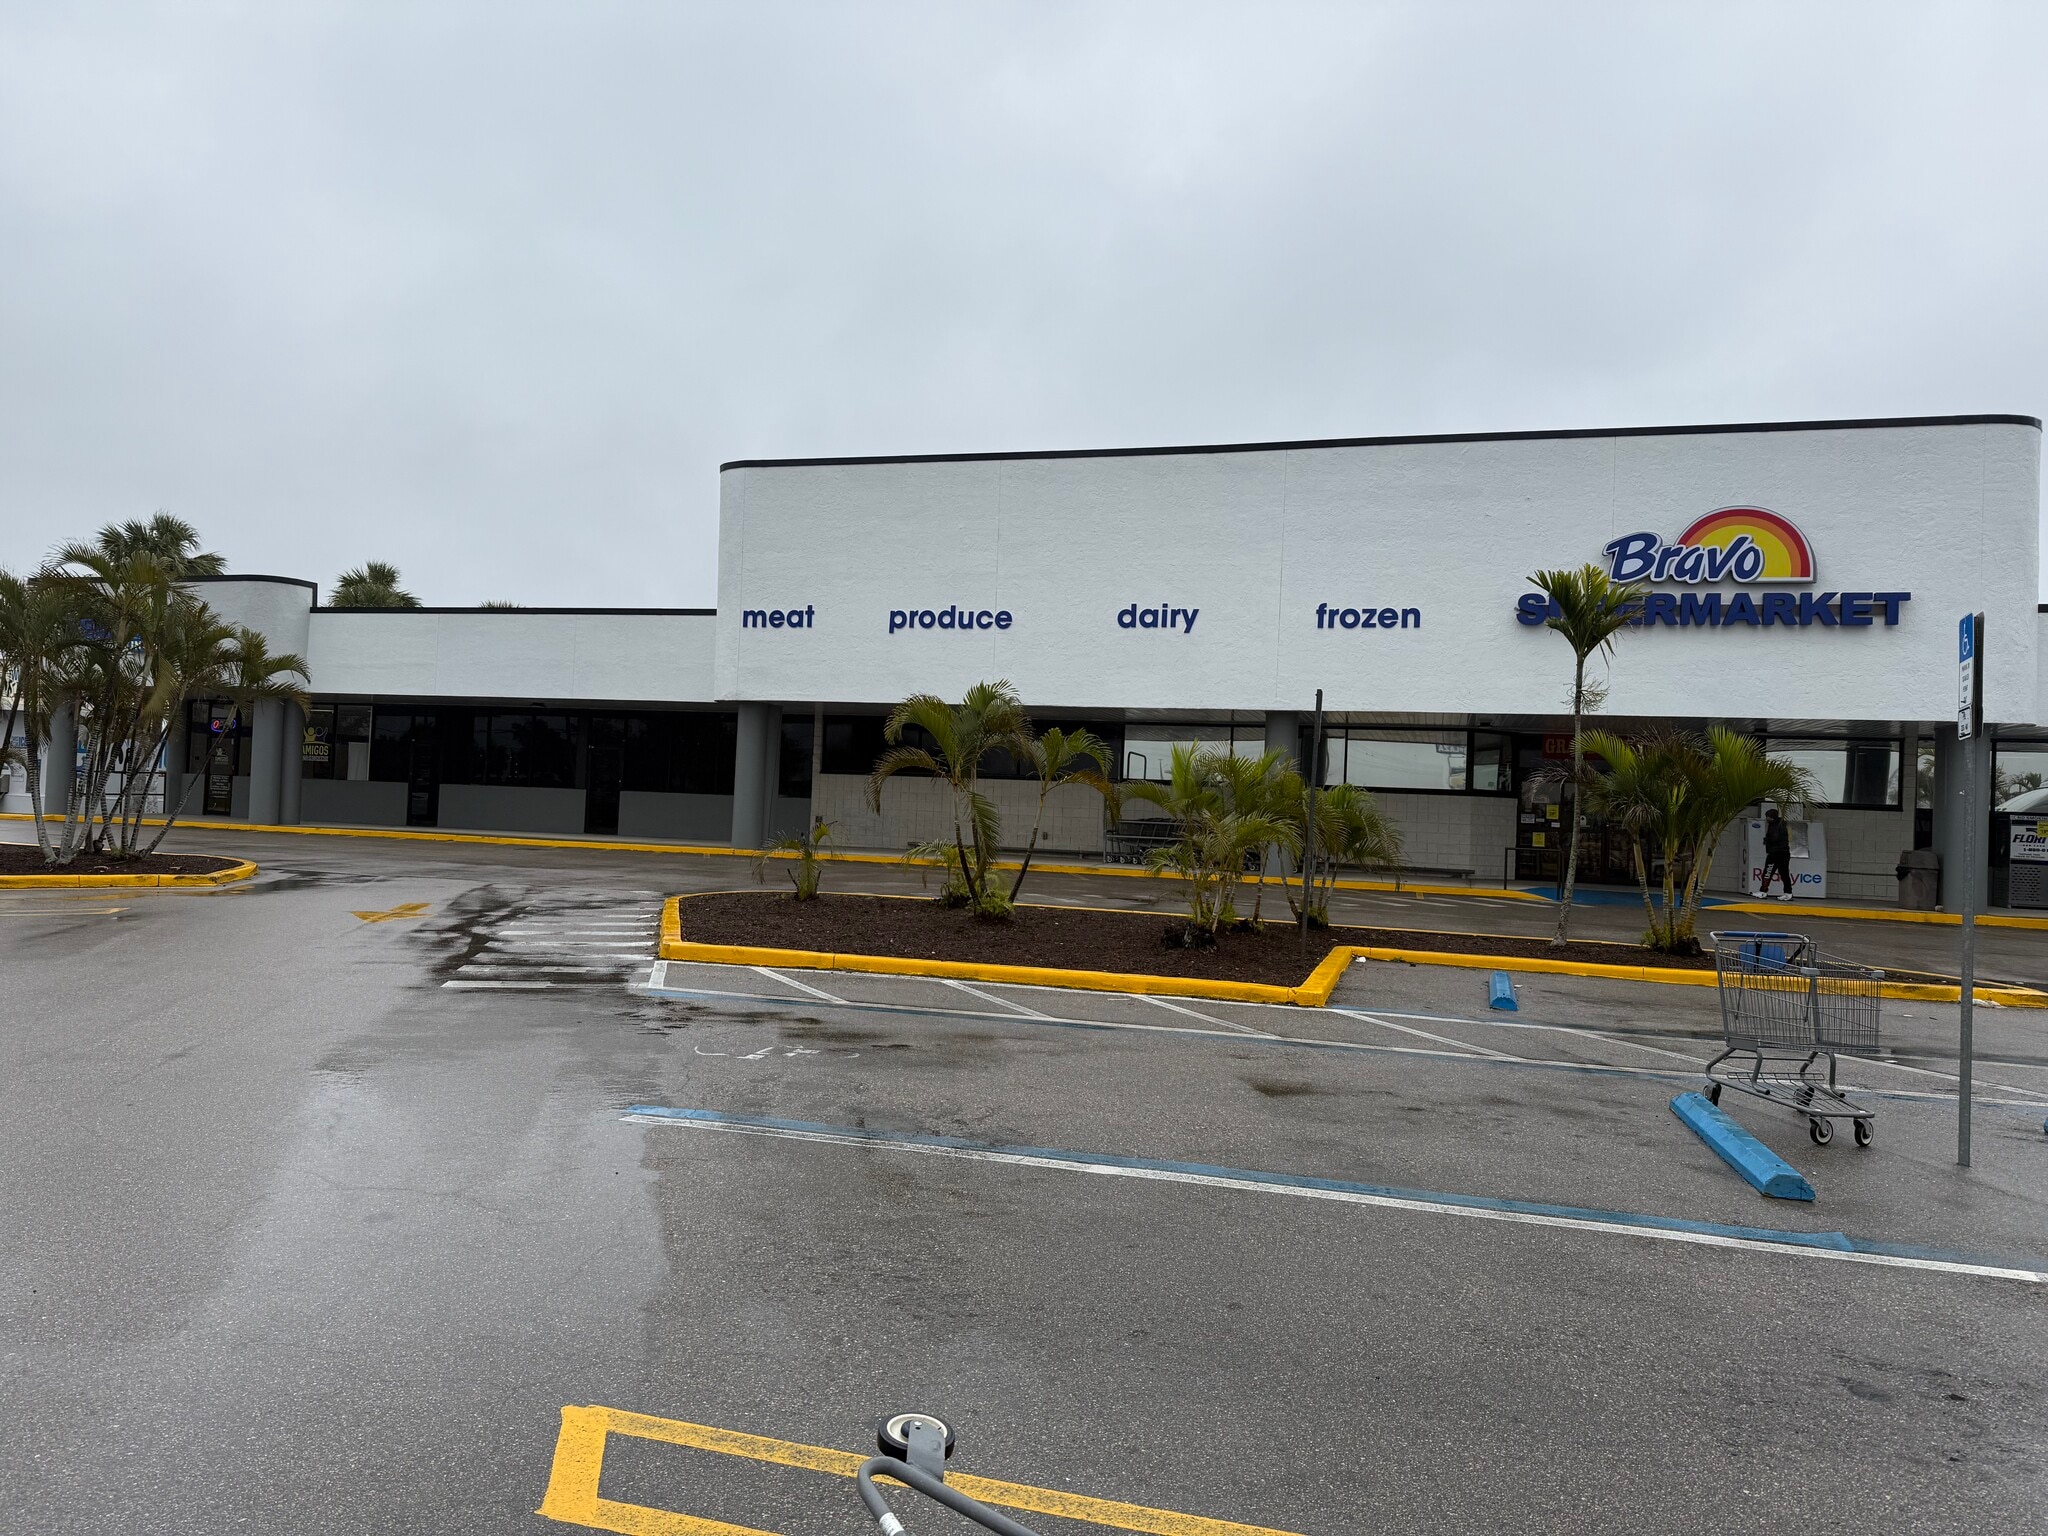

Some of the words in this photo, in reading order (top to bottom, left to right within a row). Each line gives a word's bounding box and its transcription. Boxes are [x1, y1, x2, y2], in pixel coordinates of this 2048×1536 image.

[1606, 532, 1763, 581] Bravo
[743, 604, 815, 628] meat
[889, 605, 1013, 634] produce
[1117, 603, 1199, 633] dairy
[1315, 602, 1421, 629] frozen
[1516, 592, 1911, 626] SERMARKET
